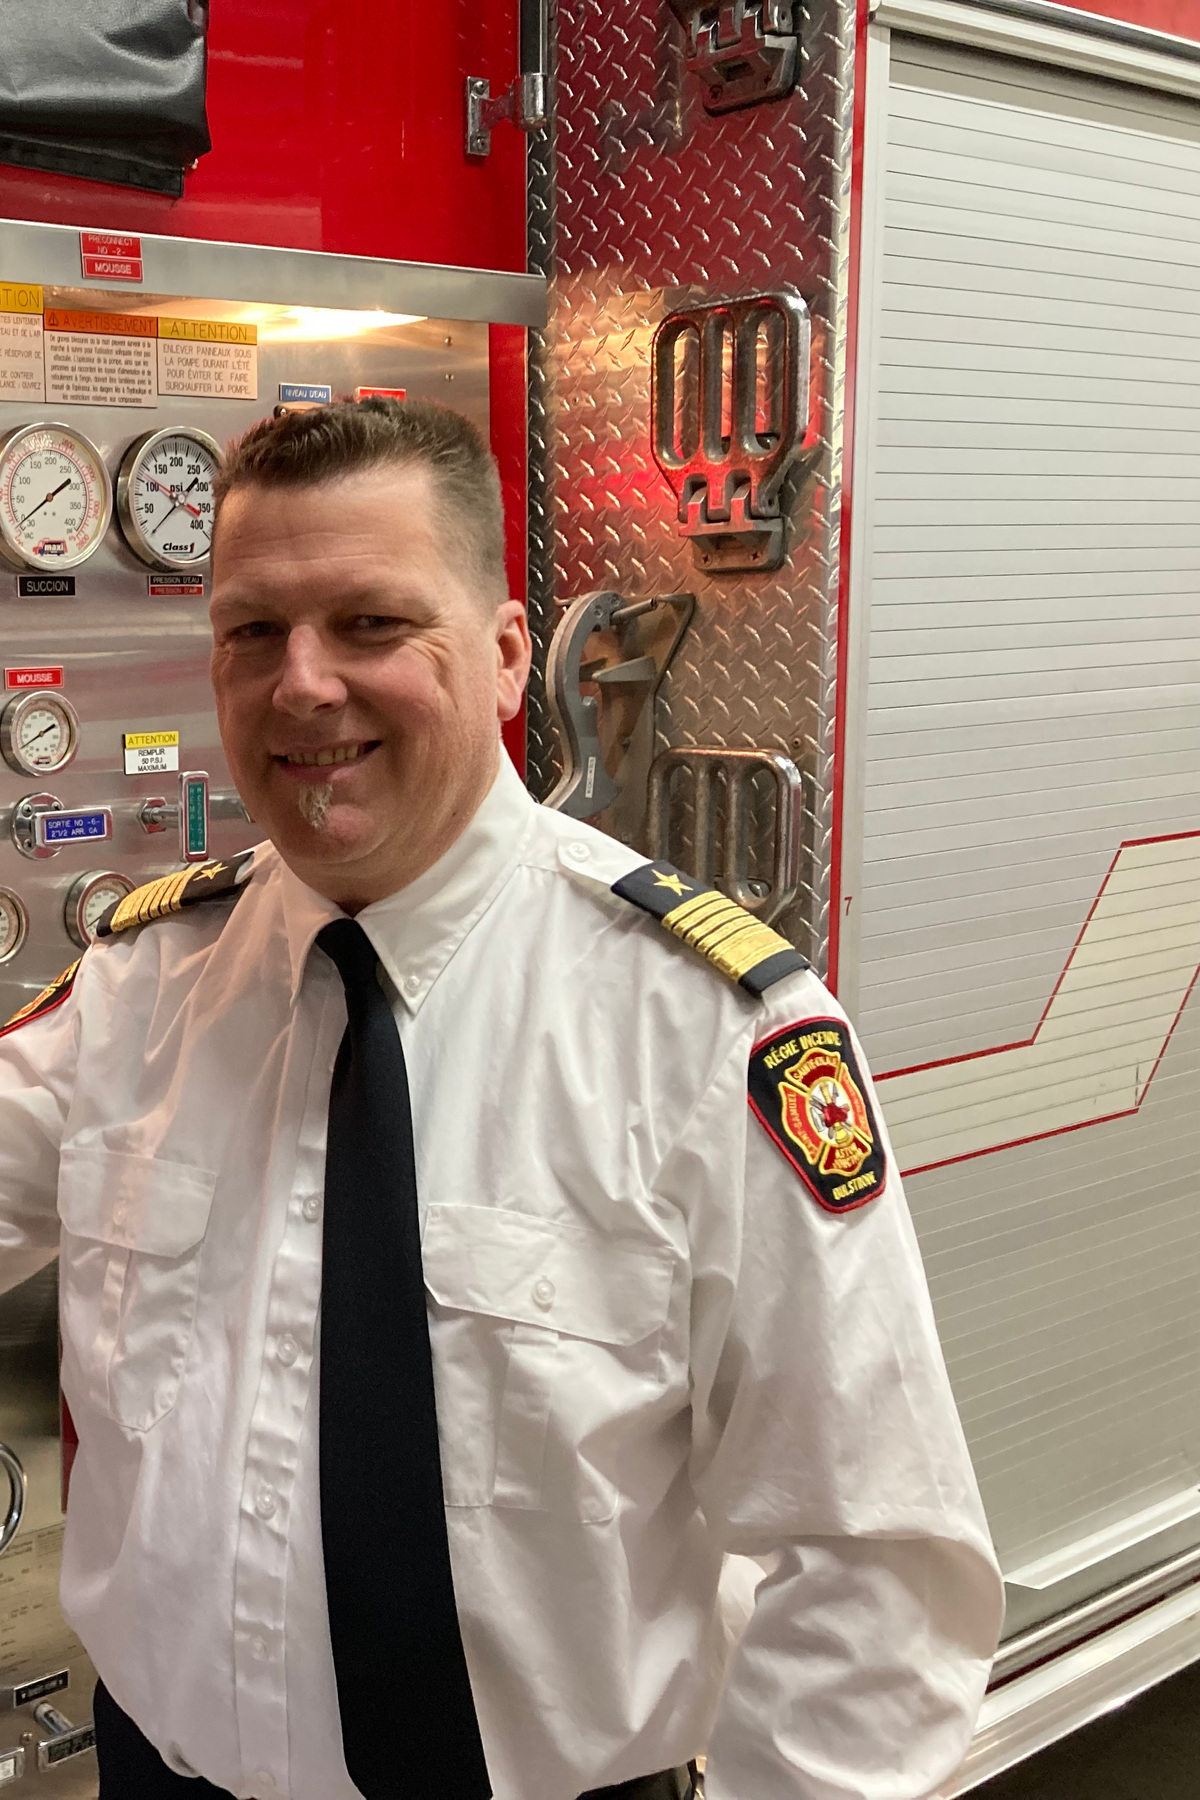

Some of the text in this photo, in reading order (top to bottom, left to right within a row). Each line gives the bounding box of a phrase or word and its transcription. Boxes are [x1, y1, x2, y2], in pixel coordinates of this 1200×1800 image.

[95, 262, 132, 275] MOUSSE
[63, 314, 154, 333] AVERTISSEMENT
[170, 321, 248, 341] ATTENTION
[163, 344, 193, 355] ENLEVER
[196, 346, 231, 358] PANNEAUX
[234, 348, 252, 359] SOUS
[164, 357, 174, 366] LA
[177, 358, 200, 368] POMPE
[203, 359, 229, 369] DURANT
[167, 368, 184, 378] POUR
[214, 371, 223, 381] DE
[230, 372, 249, 383] FAIRE
[165, 380, 212, 392] SURCHAUFFER
[214, 384, 224, 393] LA
[286, 388, 327, 398] NIVEAU D'EAU
[29, 460, 42, 470] 150
[44, 456, 57, 466] 200
[169, 456, 183, 467] 200
[60, 465, 72, 474] 250
[154, 463, 168, 475] 150
[187, 463, 201, 475] 250
[19, 476, 31, 485] 100
[68, 482, 81, 491] 300
[145, 481, 160, 492] 100
[169, 482, 183, 493] psi
[195, 481, 209, 492] 300
[16, 495, 25, 504] 50
[70, 501, 82, 510] 350
[144, 503, 154, 514] 50
[198, 502, 211, 514] 350
[26, 518, 36, 528] 30
[64, 518, 77, 527] 400
[189, 519, 204, 531] 400
[162, 541, 195, 554] Class1
[152, 576, 181, 584] PRESSION
[26, 580, 69, 593] SUCCION
[154, 587, 182, 595] PRESSION
[16, 672, 54, 684] MOUSSE
[127, 733, 177, 746] ATTENTION
[138, 748, 166, 757] REMPLIR
[141, 757, 150, 765] 50
[137, 763, 168, 772] MAXIMUM
[48, 820, 72, 829] SORTIE
[73, 819, 84, 827] NO
